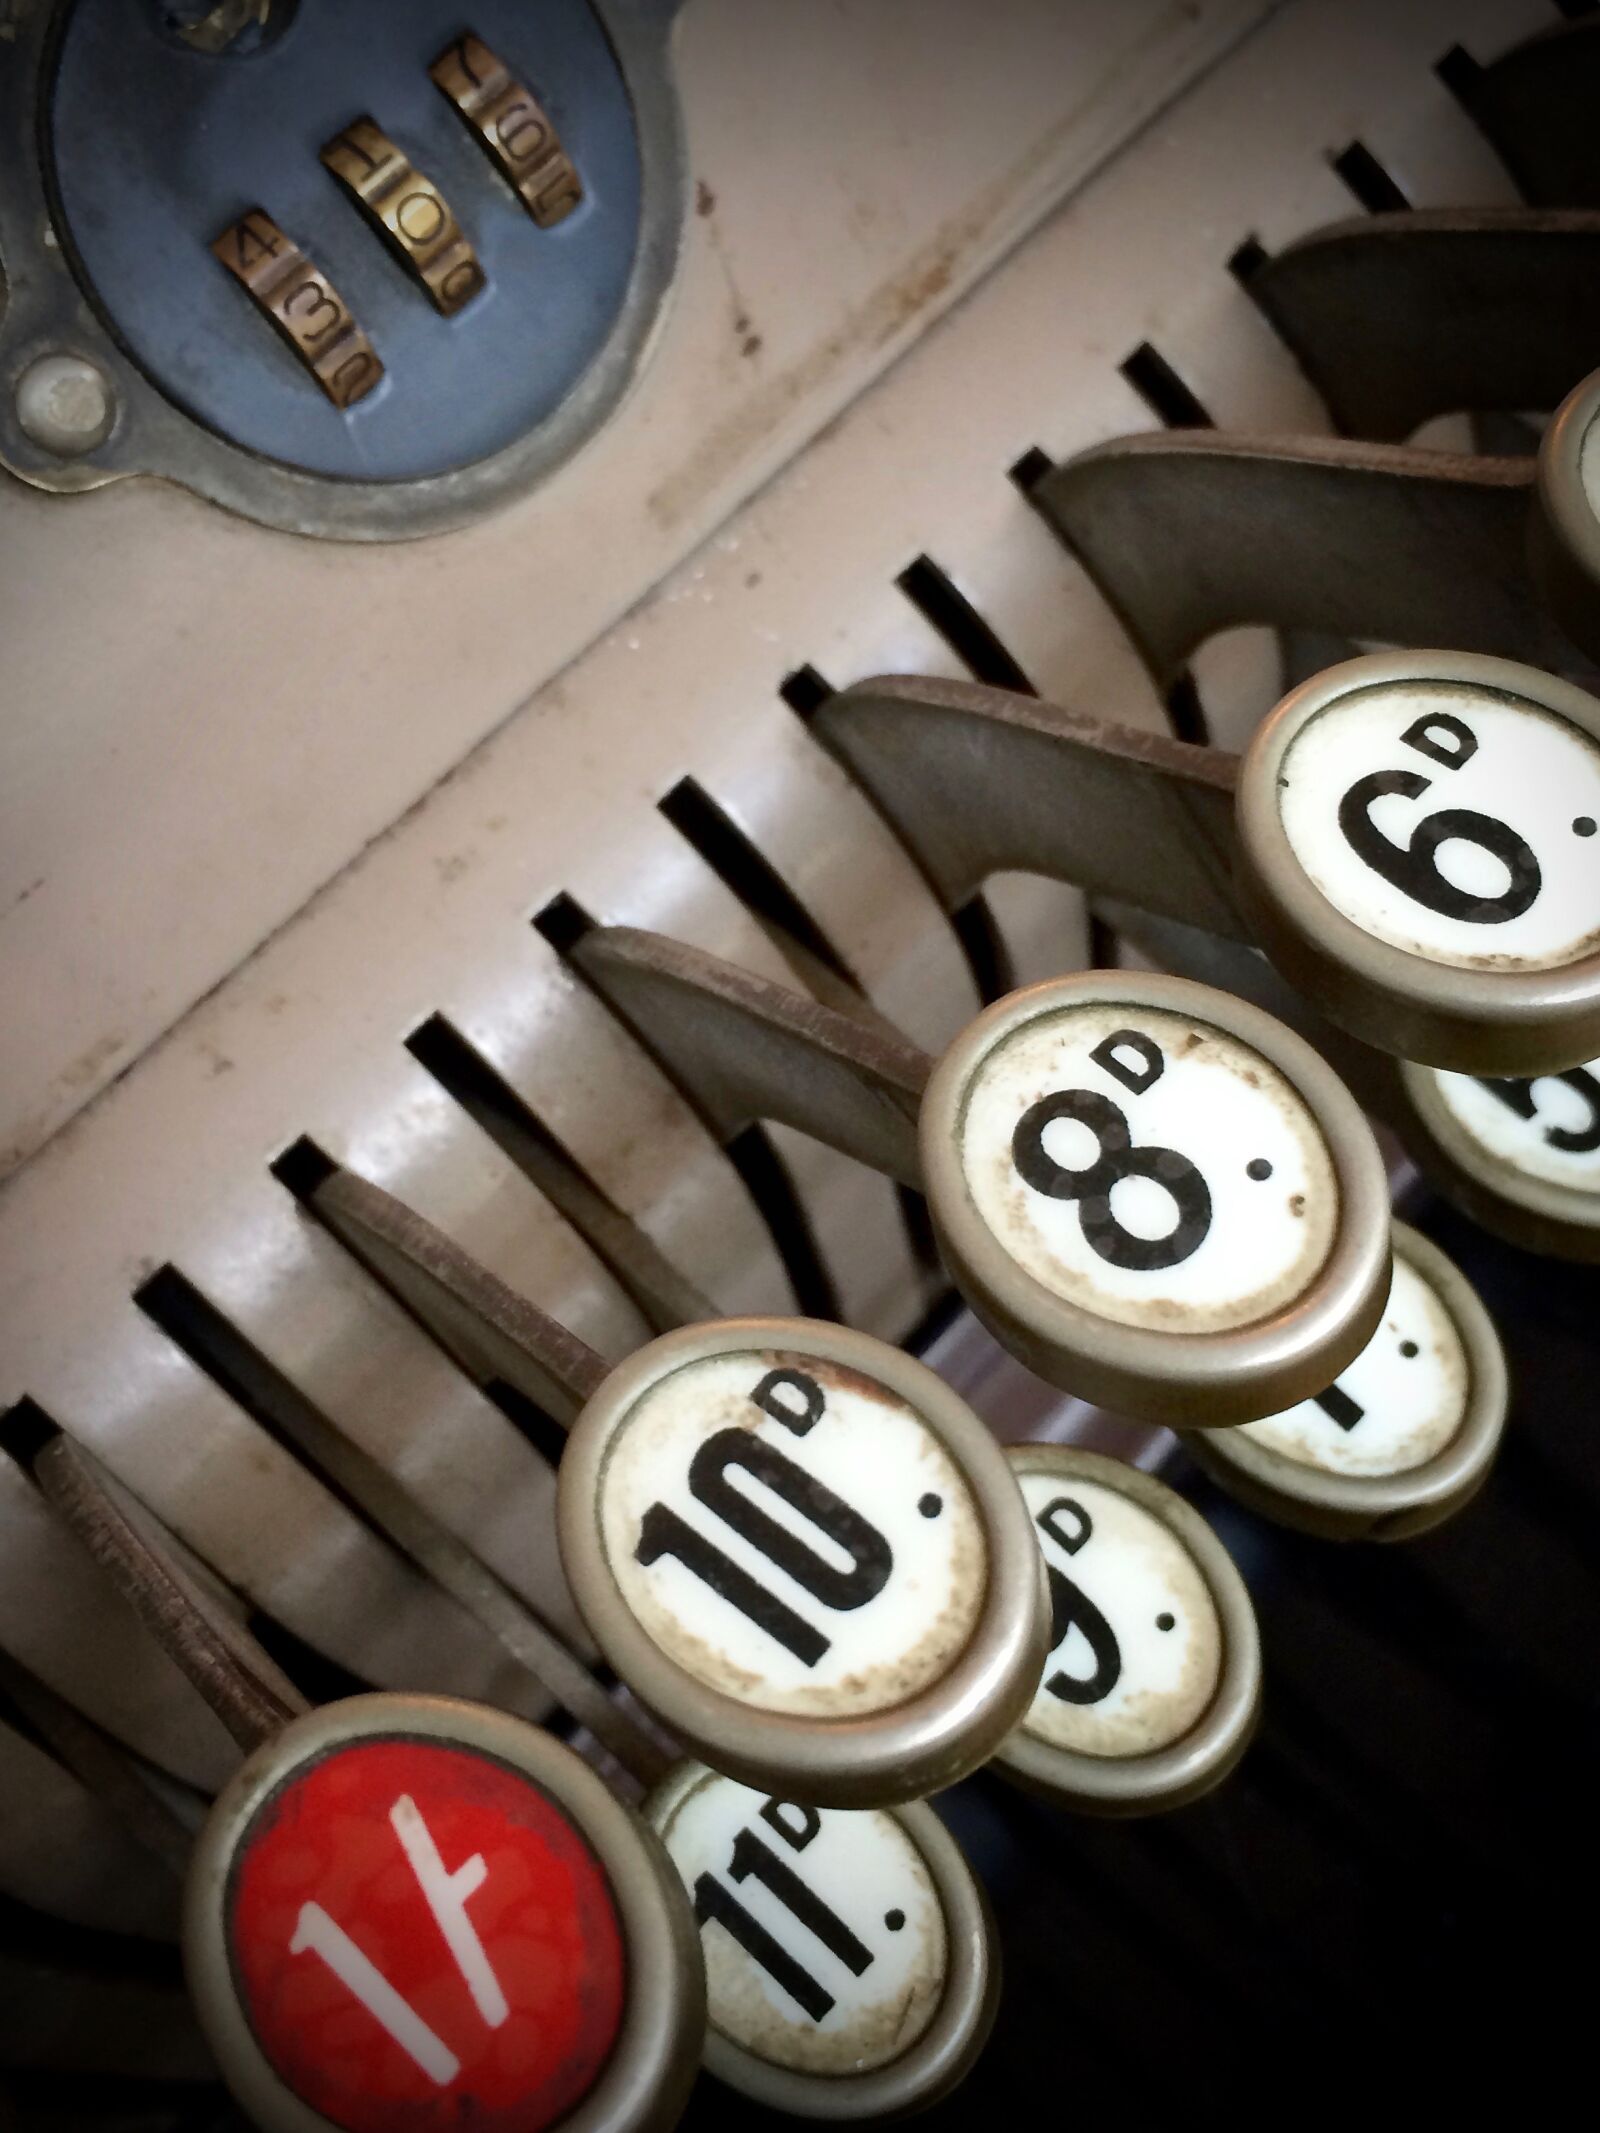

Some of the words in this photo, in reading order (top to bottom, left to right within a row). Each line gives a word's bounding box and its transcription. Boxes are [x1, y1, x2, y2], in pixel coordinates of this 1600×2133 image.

[1398, 712, 1479, 771] D
[1338, 769, 1542, 924] 6
[1089, 1029, 1164, 1095] D
[1011, 1089, 1212, 1271] 8
[751, 1368, 826, 1437] D
[634, 1427, 893, 1668] 10
[1035, 1496, 1093, 1556] D
[694, 1827, 874, 2022] 11
